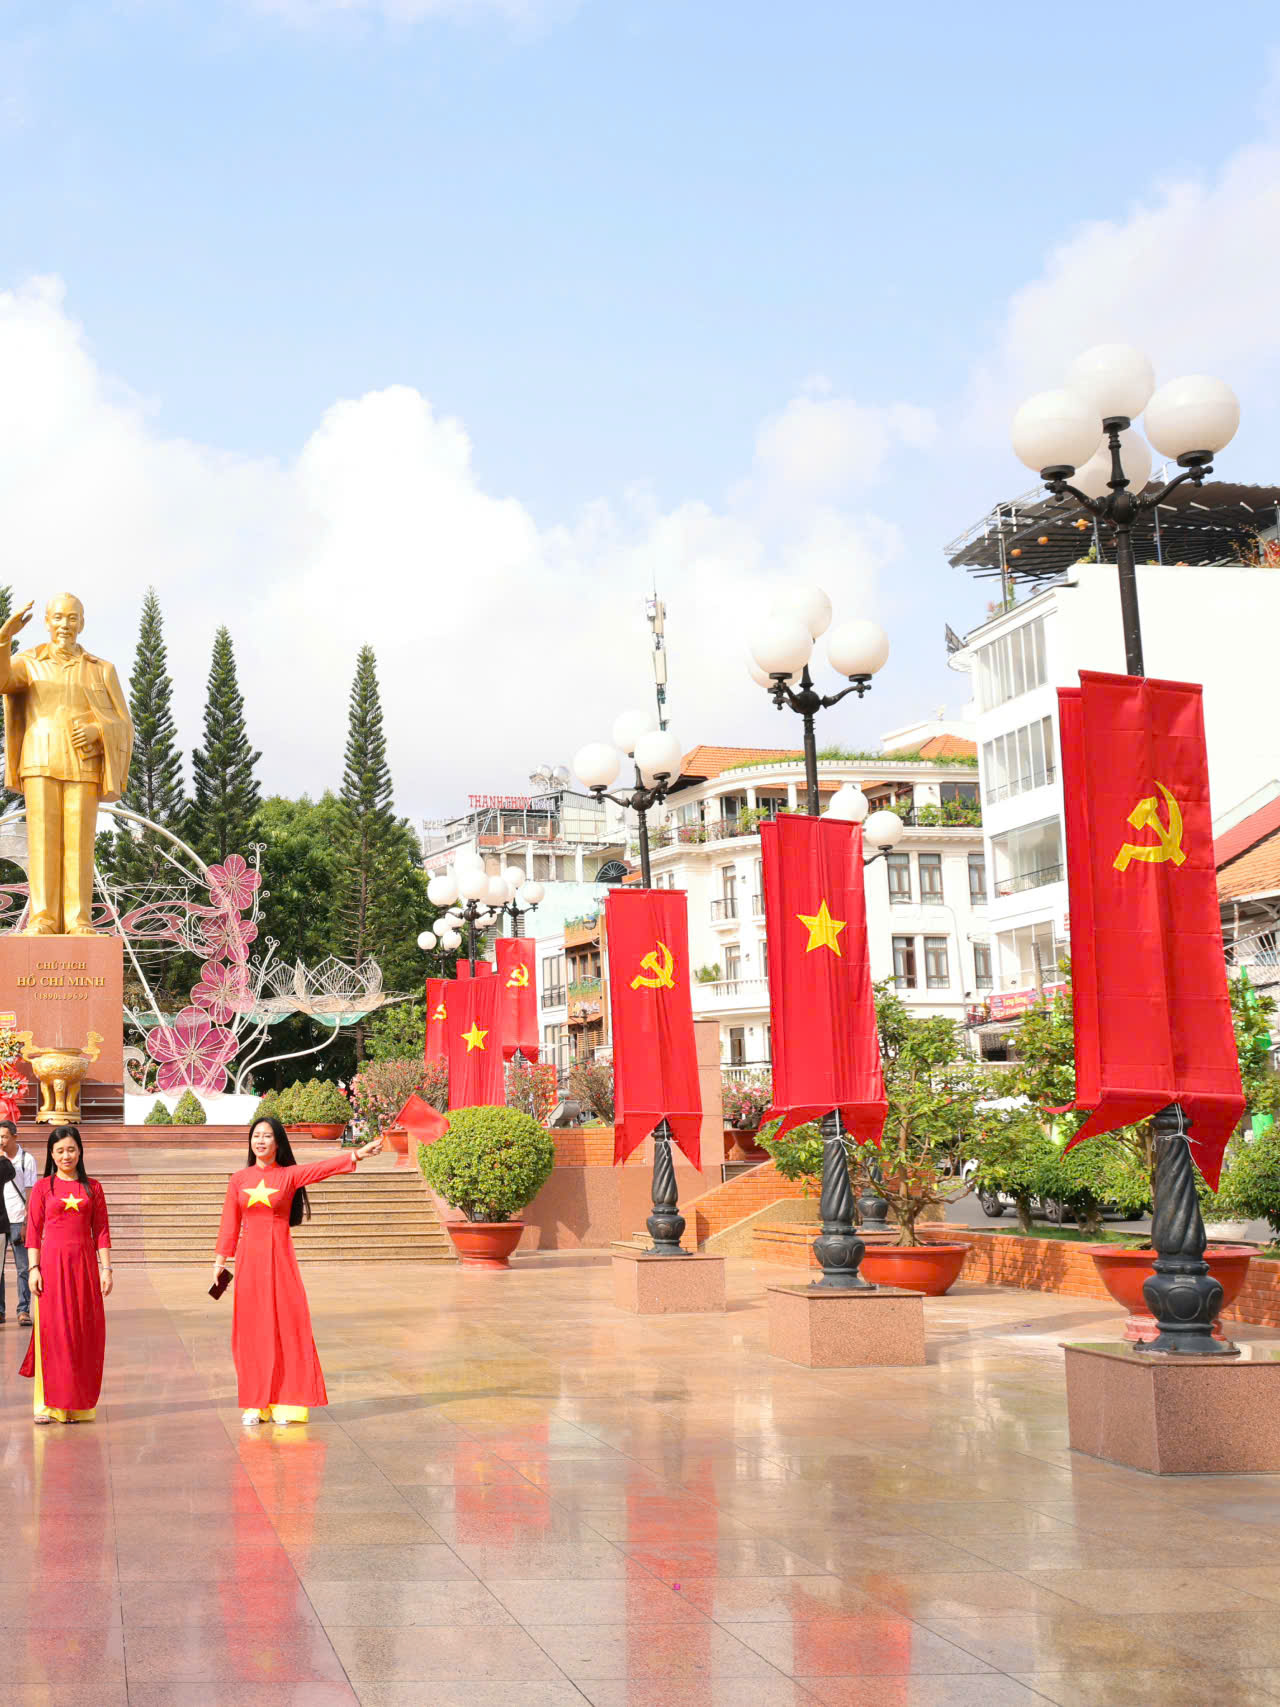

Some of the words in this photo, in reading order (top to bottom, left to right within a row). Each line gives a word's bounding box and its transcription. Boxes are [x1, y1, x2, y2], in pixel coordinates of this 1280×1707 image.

[468, 795, 504, 809] THANH
[40, 975, 64, 987] CHÍ
[68, 975, 105, 987] MINH
